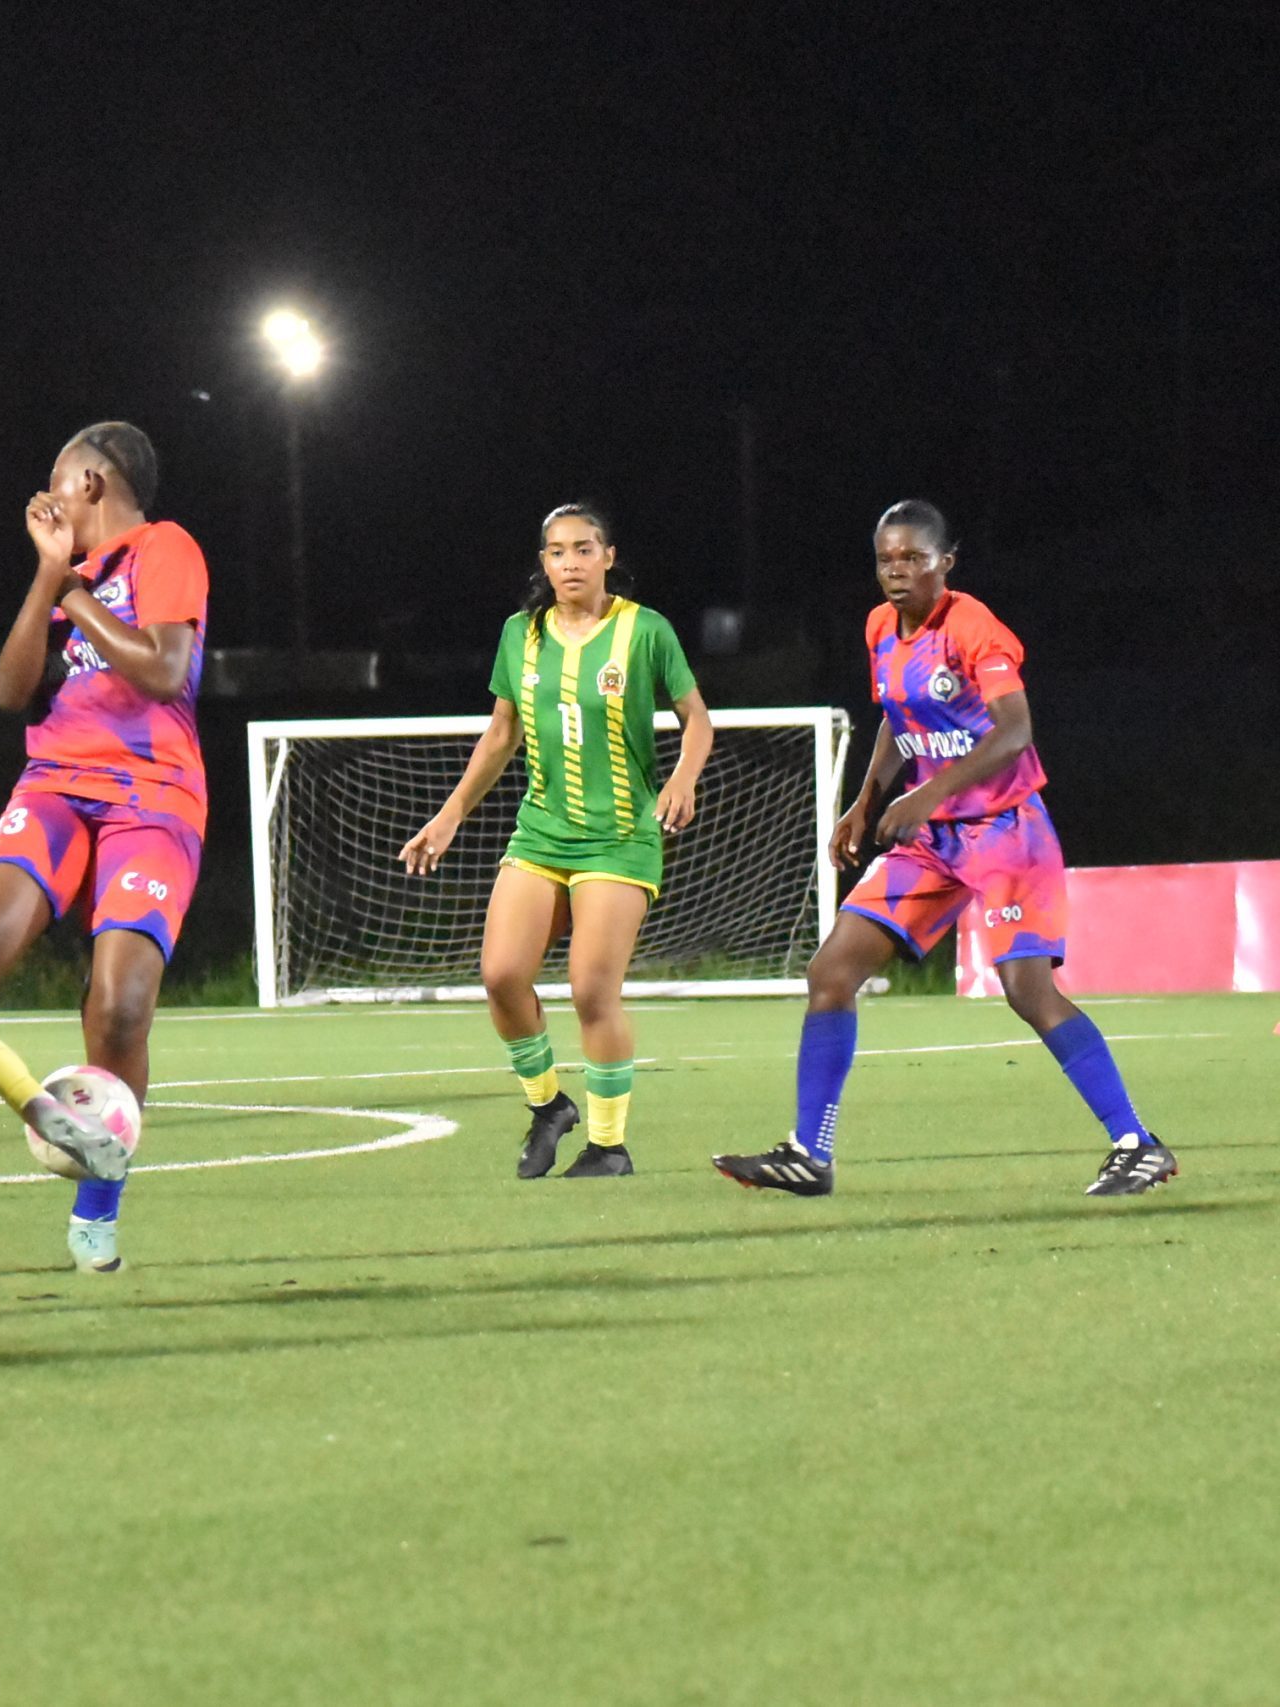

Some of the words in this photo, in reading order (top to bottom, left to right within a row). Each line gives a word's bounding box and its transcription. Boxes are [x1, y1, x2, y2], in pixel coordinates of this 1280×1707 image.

[557, 703, 583, 746] 11
[147, 879, 168, 901] 90
[1001, 904, 1022, 923] 90
